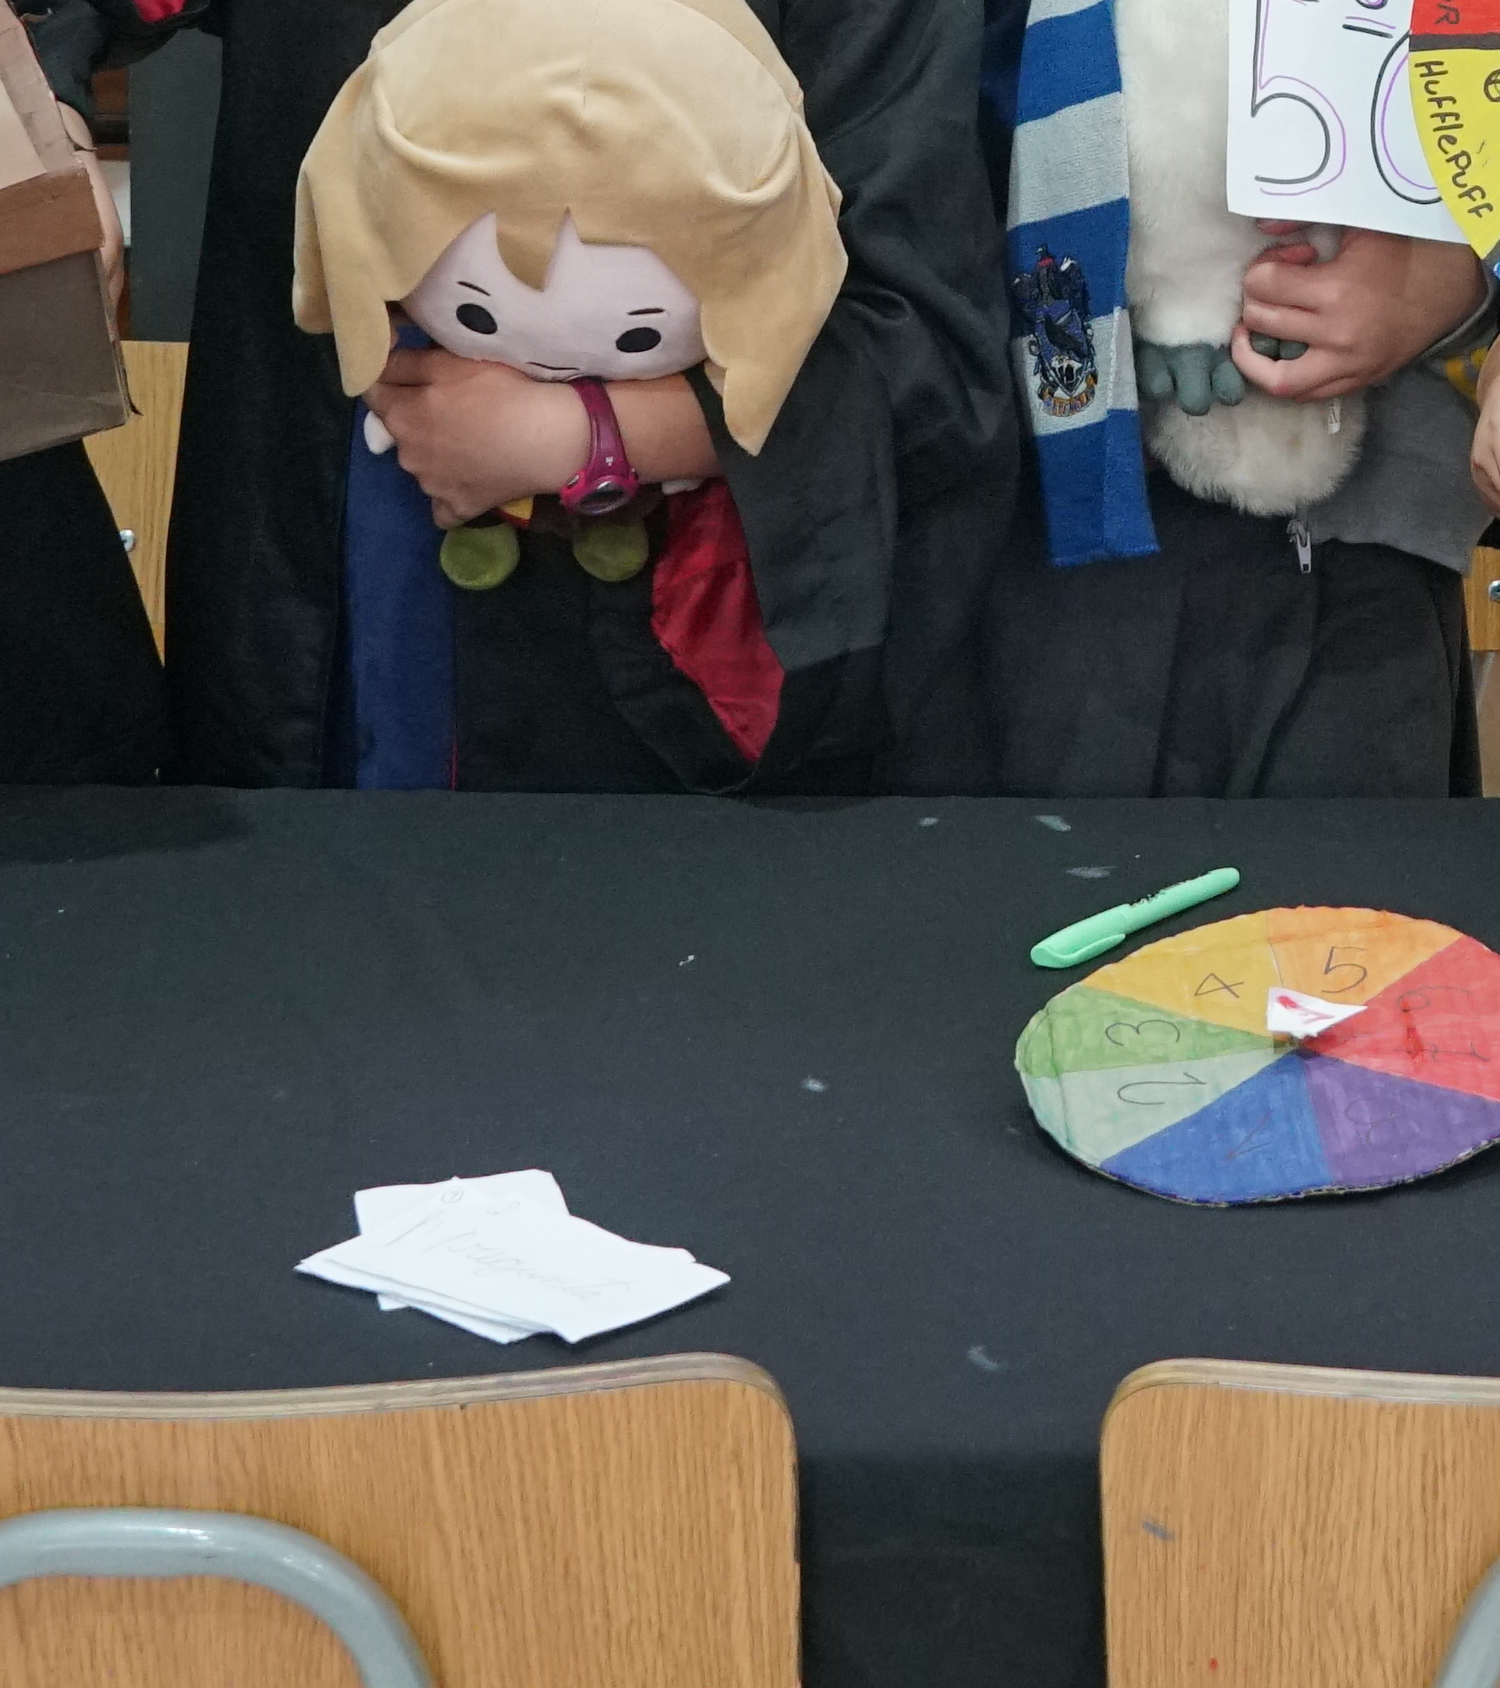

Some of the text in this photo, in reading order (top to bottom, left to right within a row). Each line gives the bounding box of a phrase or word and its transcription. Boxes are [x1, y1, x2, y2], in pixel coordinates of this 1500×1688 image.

[1320, 945, 1368, 994] 5
[1104, 1019, 1181, 1047] 3
[1116, 1071, 1208, 1106] 2
